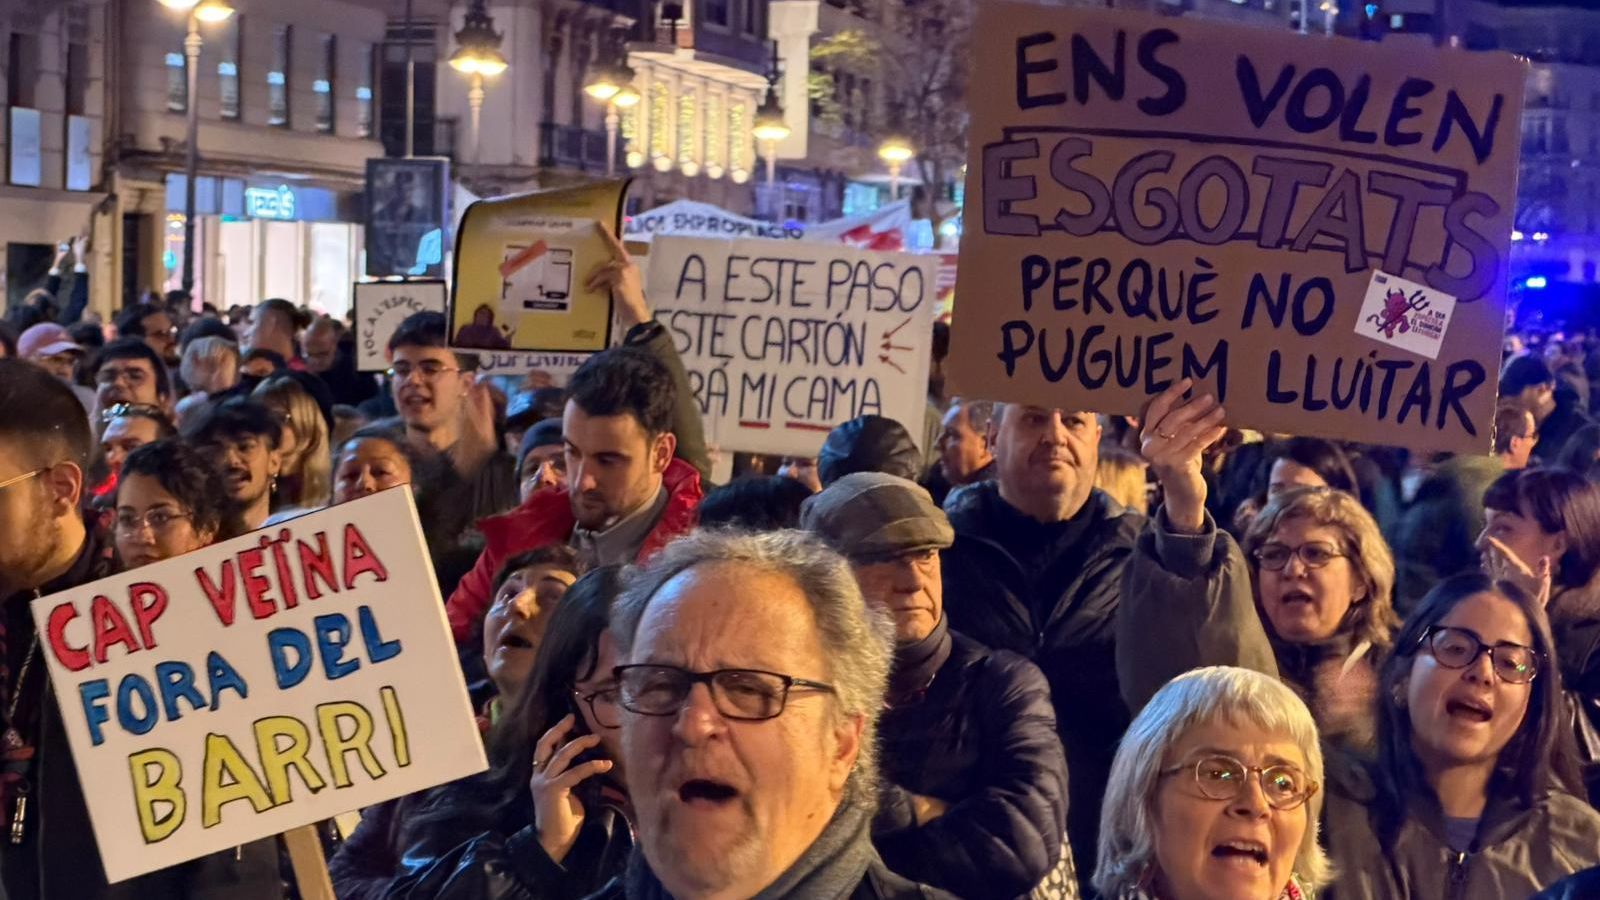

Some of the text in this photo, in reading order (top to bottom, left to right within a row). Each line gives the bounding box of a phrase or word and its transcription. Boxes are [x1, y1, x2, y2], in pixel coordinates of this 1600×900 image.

[1015, 28, 1503, 164] ENS VOLEN
[982, 138, 1501, 302] ESGOTATS
[676, 254, 706, 301] A
[724, 255, 816, 308] ESTE
[826, 259, 924, 312] PASO
[1021, 254, 1336, 336] PERQUÈ NO
[688, 361, 882, 421] RÁ MI CAMA
[741, 311, 867, 368] CARTÓN
[997, 319, 1229, 404] PUGUEM
[47, 523, 388, 672] CAP VEÏNA
[79, 606, 402, 747] FORA DEL
[128, 686, 411, 844] BARRI
